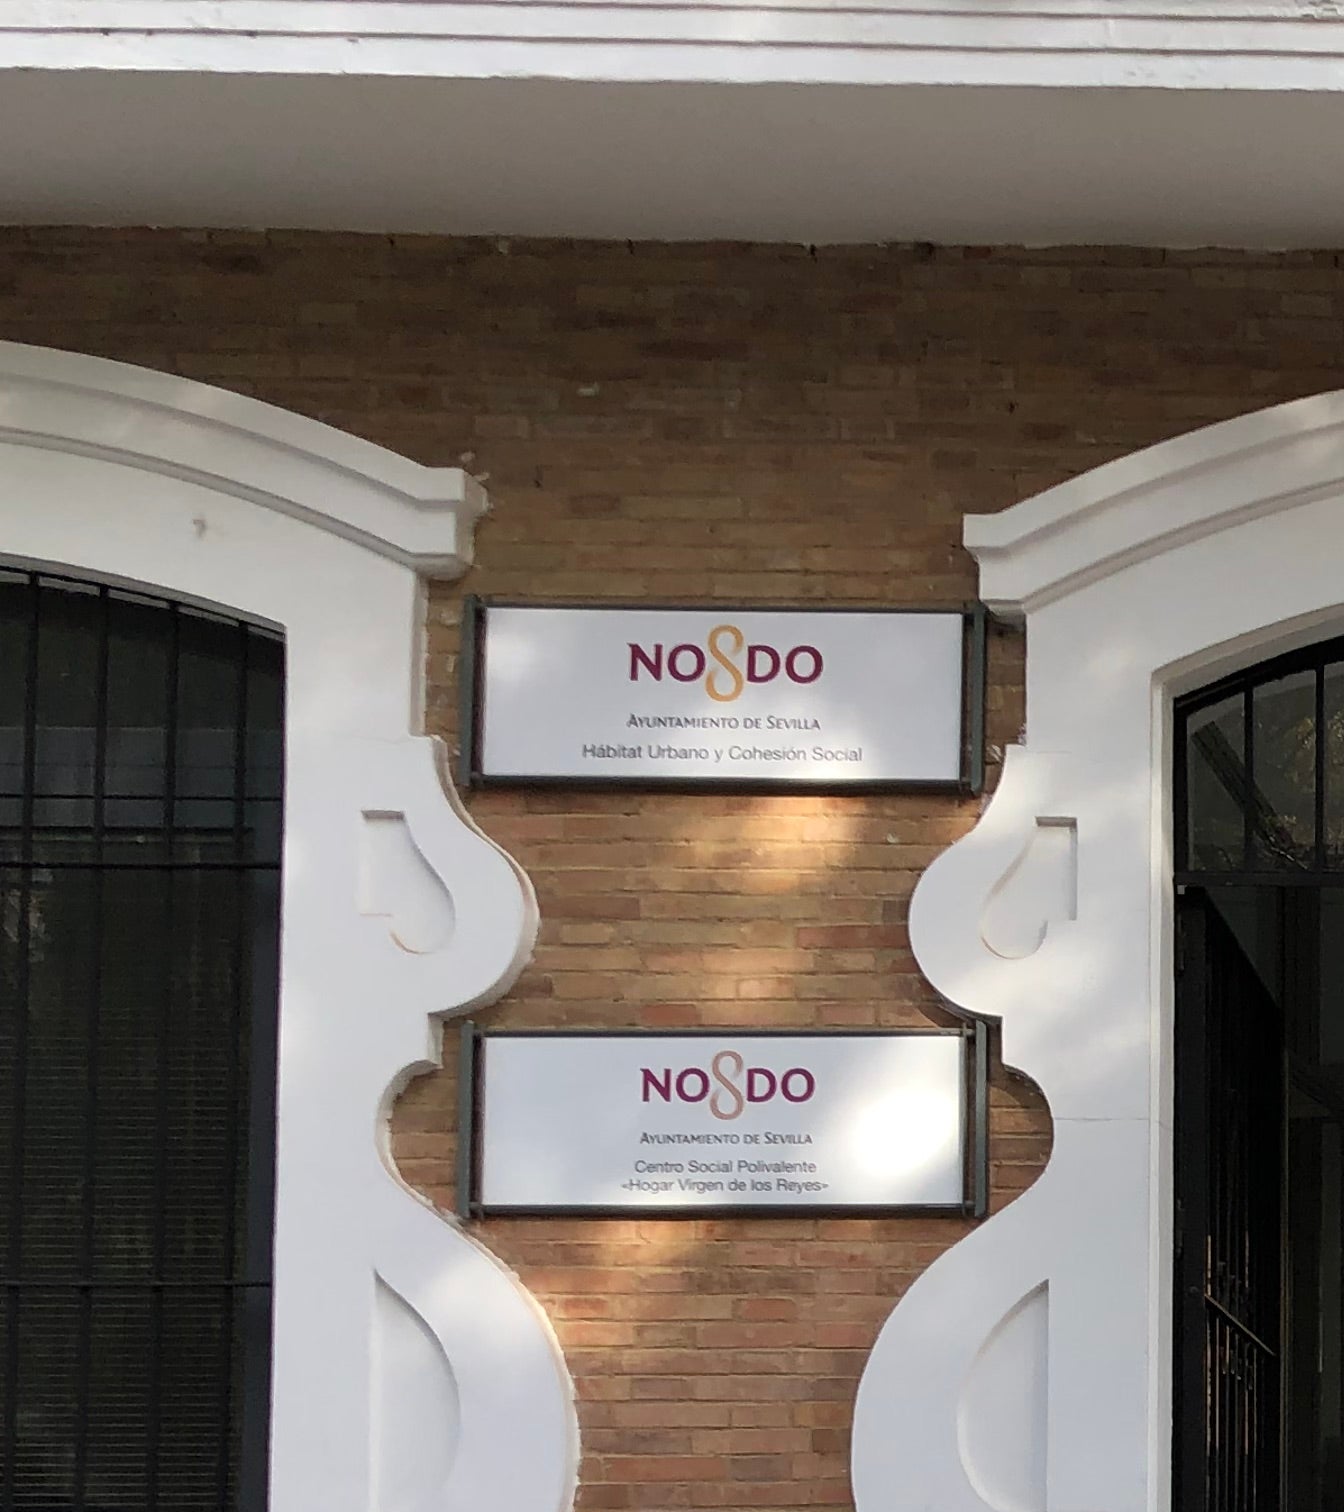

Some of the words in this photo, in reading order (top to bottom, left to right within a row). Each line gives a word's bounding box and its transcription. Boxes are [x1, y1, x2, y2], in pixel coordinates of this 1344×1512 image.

[581, 744, 642, 759] Hábitat
[648, 744, 709, 760] Urbano
[713, 748, 723, 763] y
[729, 745, 806, 761] Cohesión
[811, 746, 863, 762] Social
[634, 1160, 684, 1174] Centro
[688, 1160, 733, 1174] Social
[737, 1160, 817, 1174] Polivalente
[678, 1179, 723, 1193] Virgen
[728, 1179, 747, 1192] de
[751, 1179, 772, 1192] los
